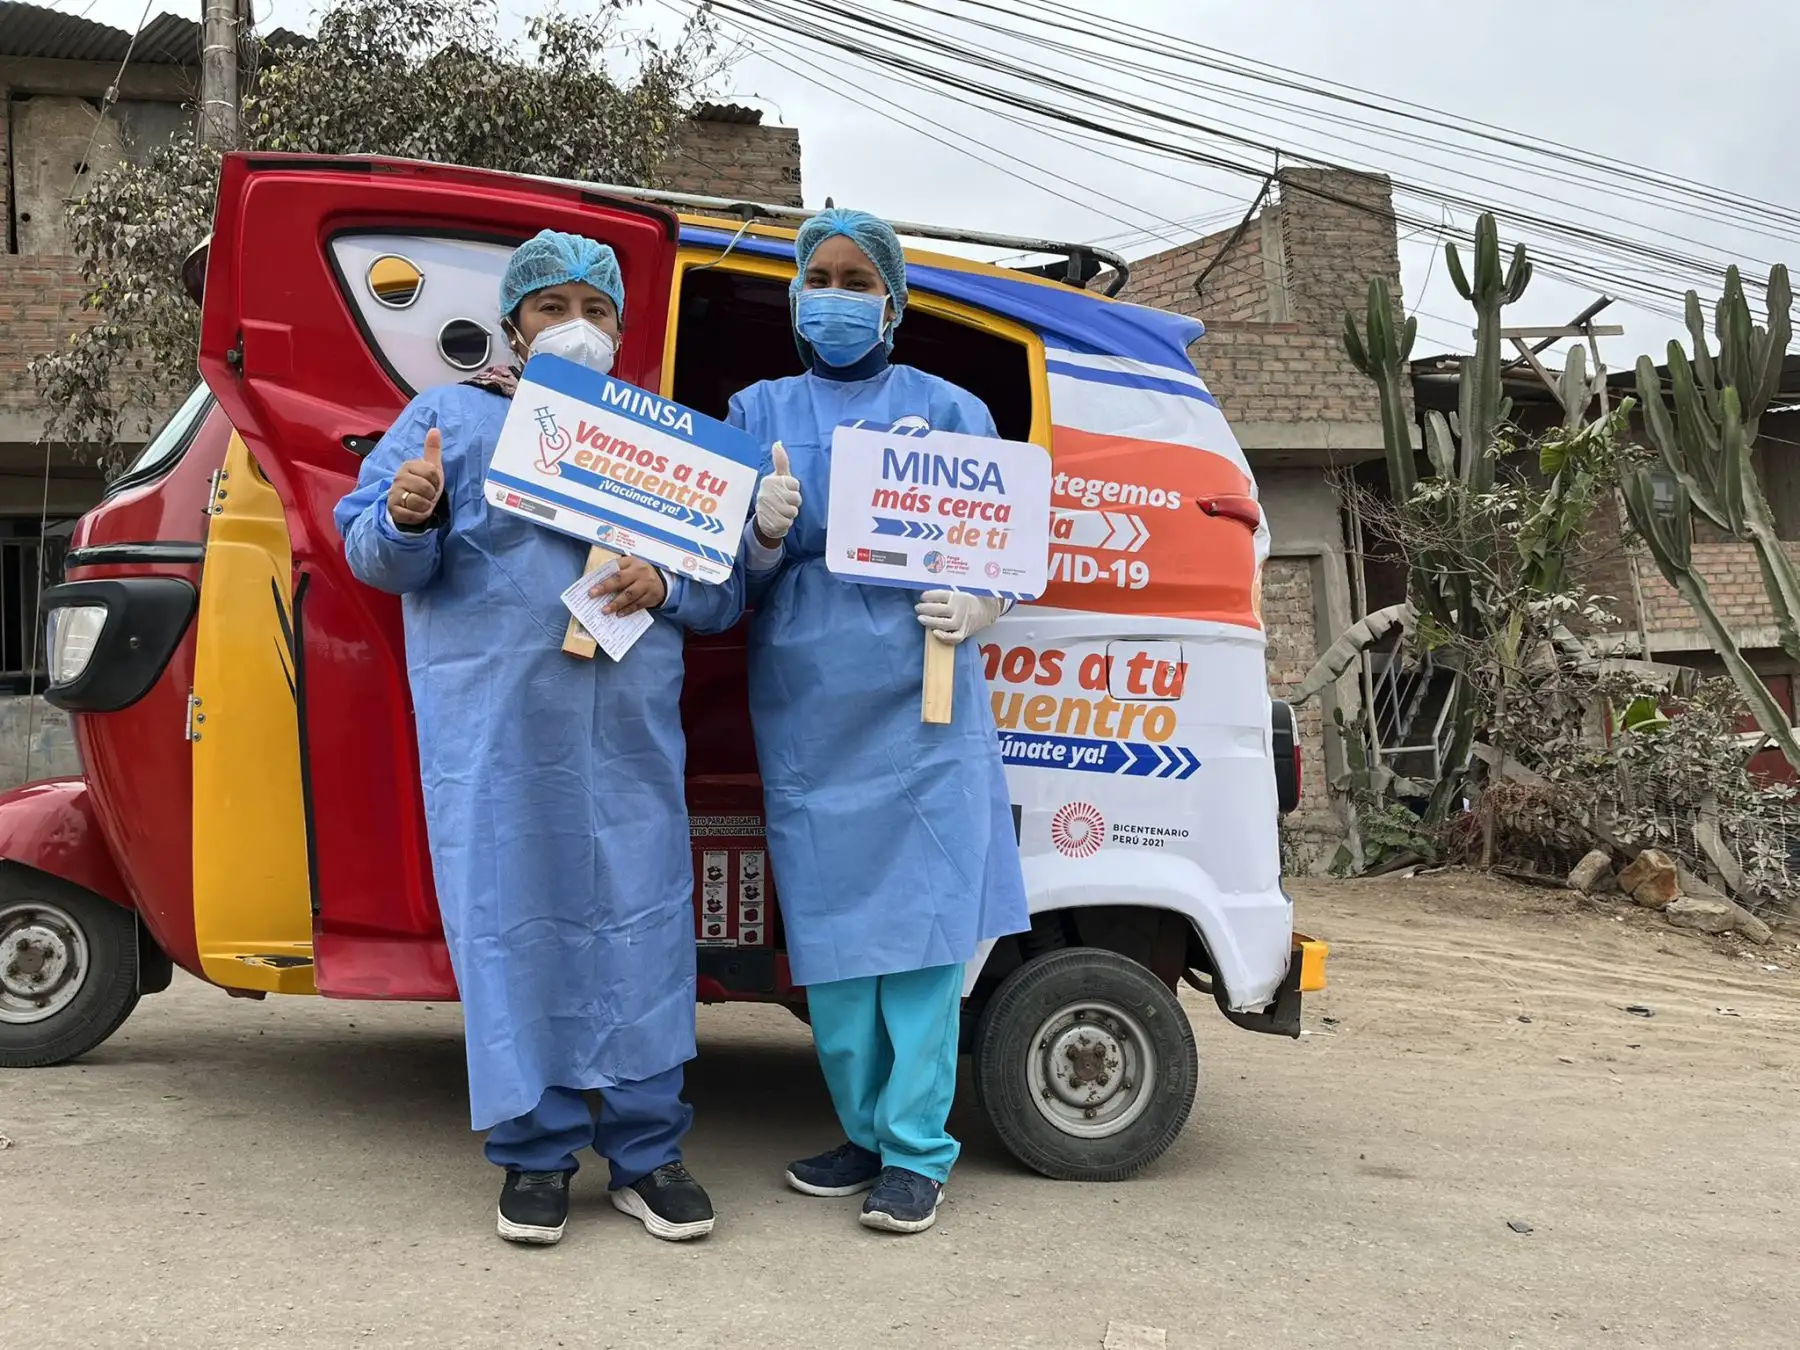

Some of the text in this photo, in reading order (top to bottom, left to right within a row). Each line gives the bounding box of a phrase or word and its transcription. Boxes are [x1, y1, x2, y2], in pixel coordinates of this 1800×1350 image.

[601, 381, 694, 436] MINSA
[575, 420, 729, 497] Vamos a tu
[882, 447, 1006, 495] MINSA
[574, 449, 718, 514] encuentro
[599, 480, 681, 516] ¡Vacúnate ya!
[1051, 472, 1181, 510] tegemos
[871, 486, 1012, 523] más cerca
[946, 520, 981, 547] de
[1078, 653, 1115, 691] a
[1126, 651, 1190, 698] tu
[990, 690, 1177, 743] uentro
[1068, 744, 1108, 768] ya!
[1112, 834, 1164, 847] PERÚ 2021
[1113, 823, 1189, 838] BICENTENARIO
